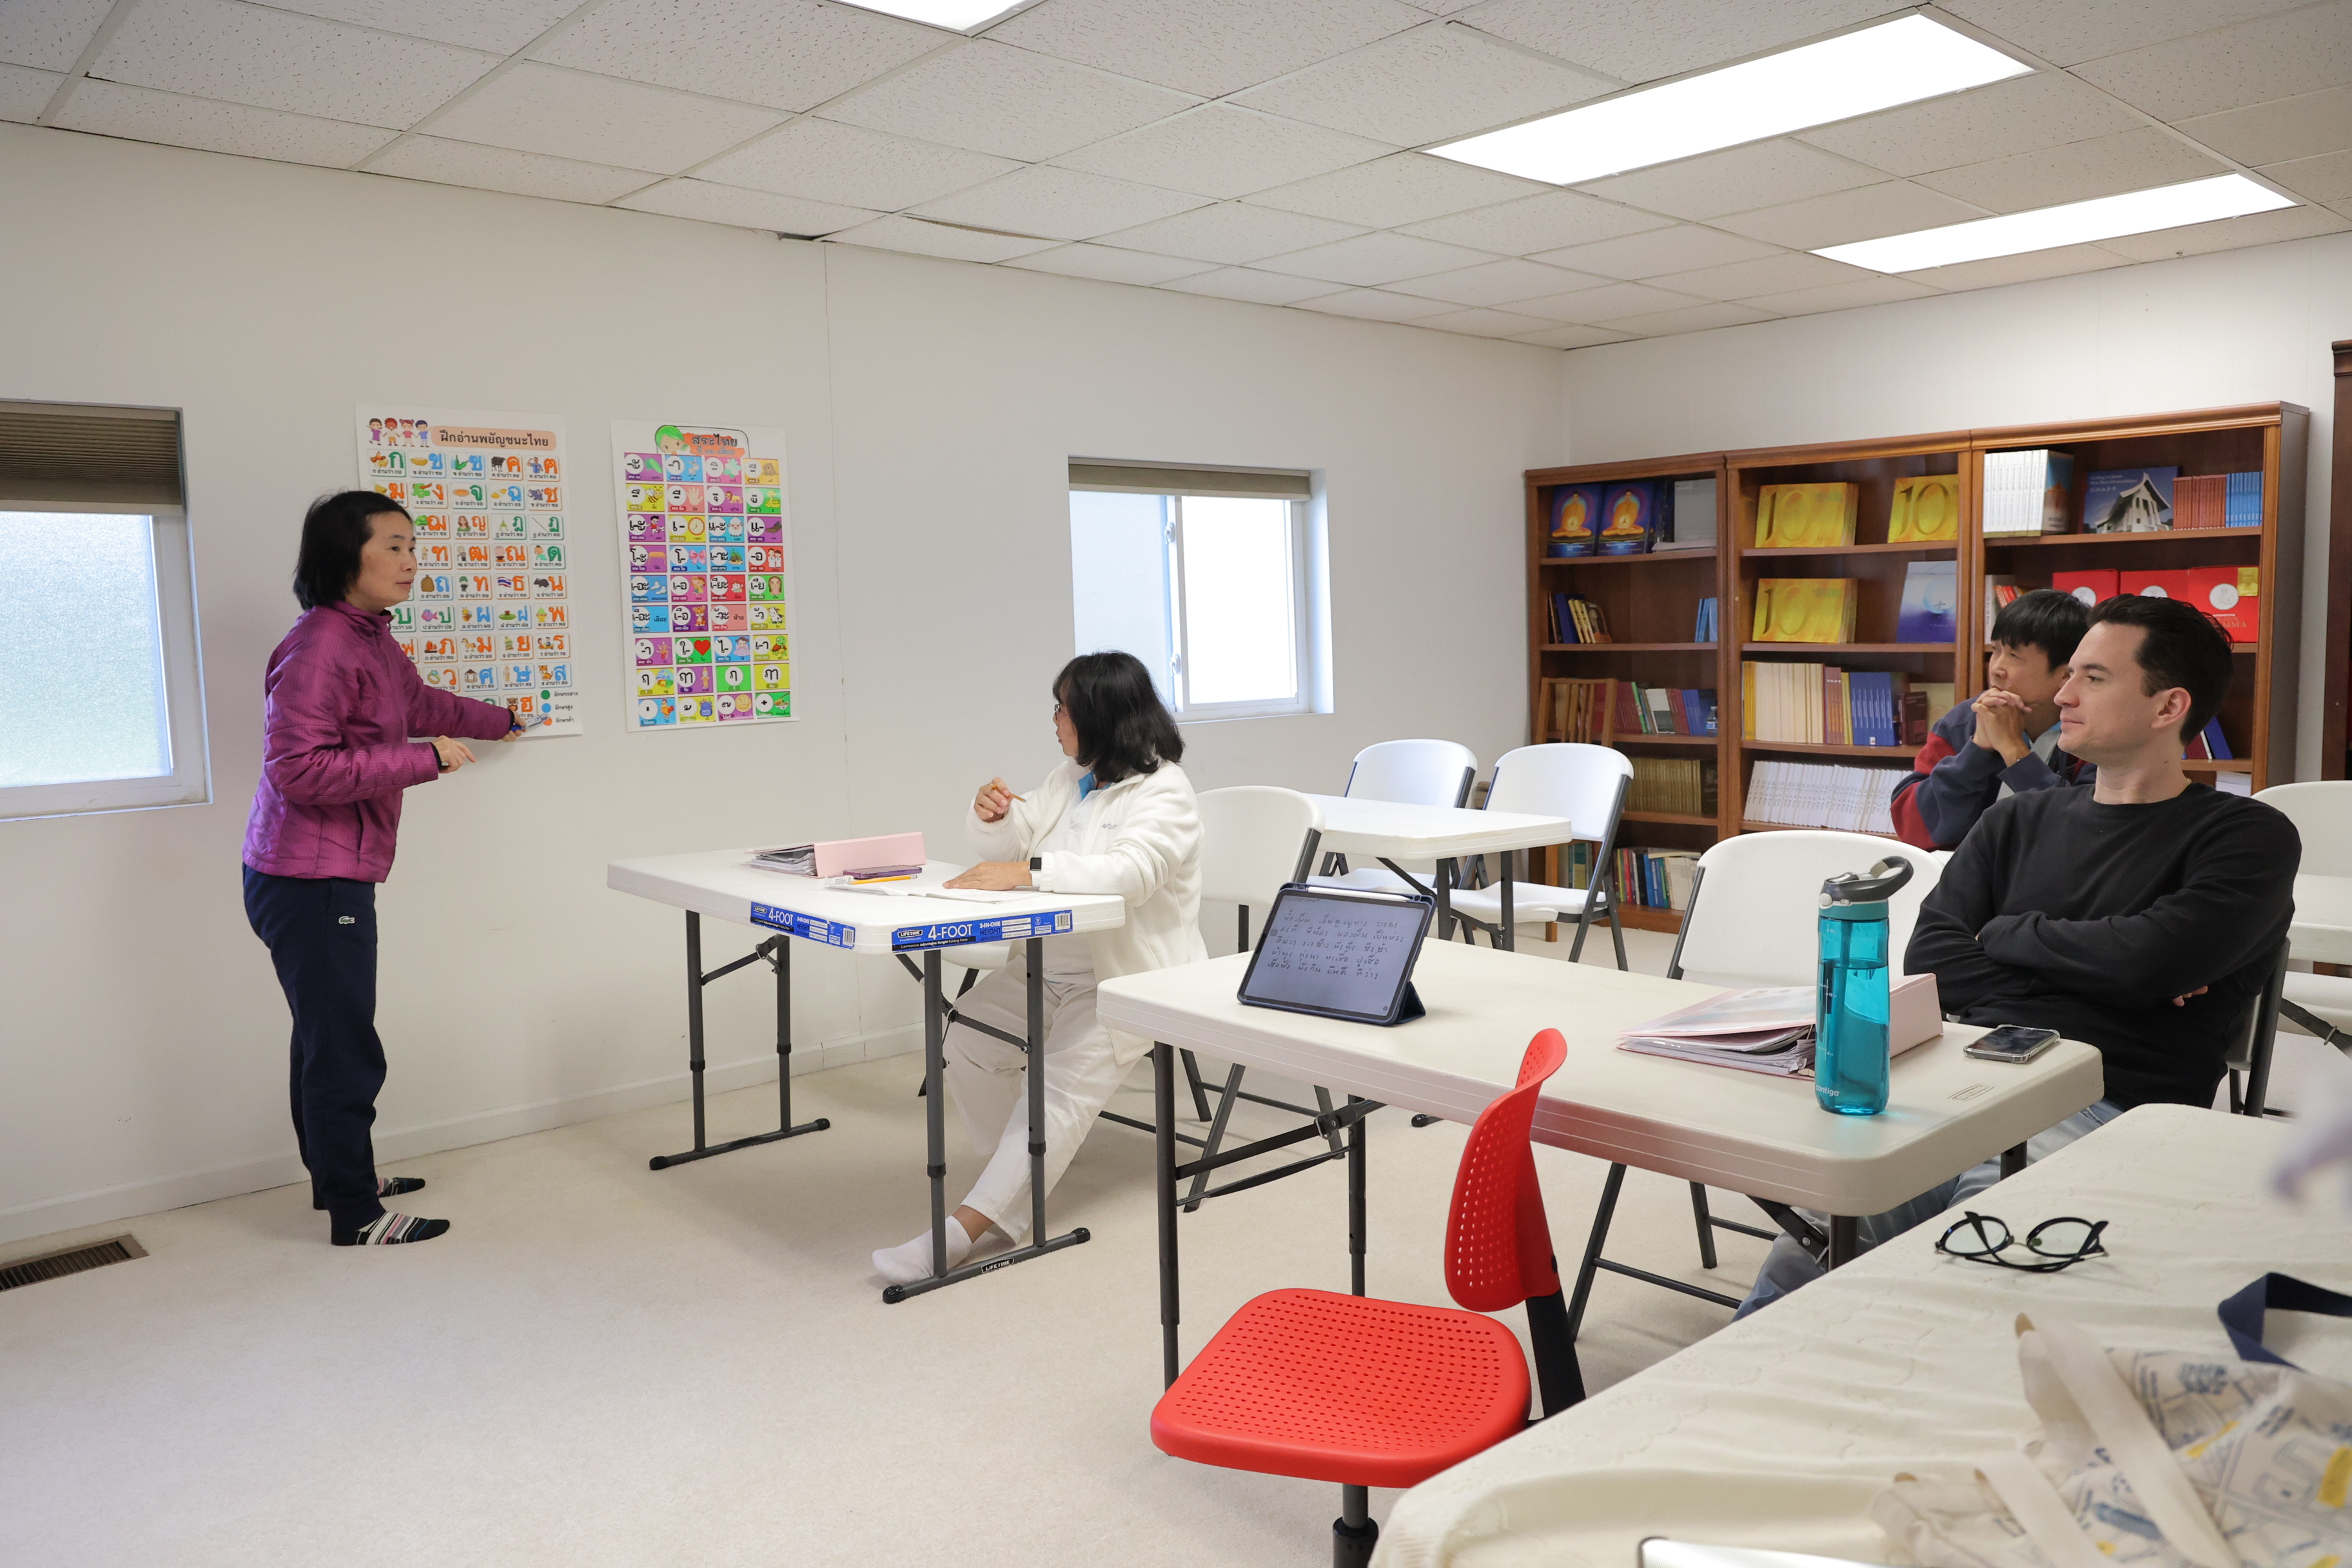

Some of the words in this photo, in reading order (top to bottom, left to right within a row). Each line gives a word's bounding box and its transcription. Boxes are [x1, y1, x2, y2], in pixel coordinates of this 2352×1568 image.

[440, 430, 549, 447] ฝึกอ่านพยัญชนะไทย
[692, 433, 738, 447] สระไทย
[1898, 482, 1950, 536] 10
[769, 908, 794, 925] 4-FOOT
[928, 924, 972, 939] 4-FOOT
[1816, 1084, 1839, 1097] contigo
[985, 1260, 1010, 1271] LIFETIME
